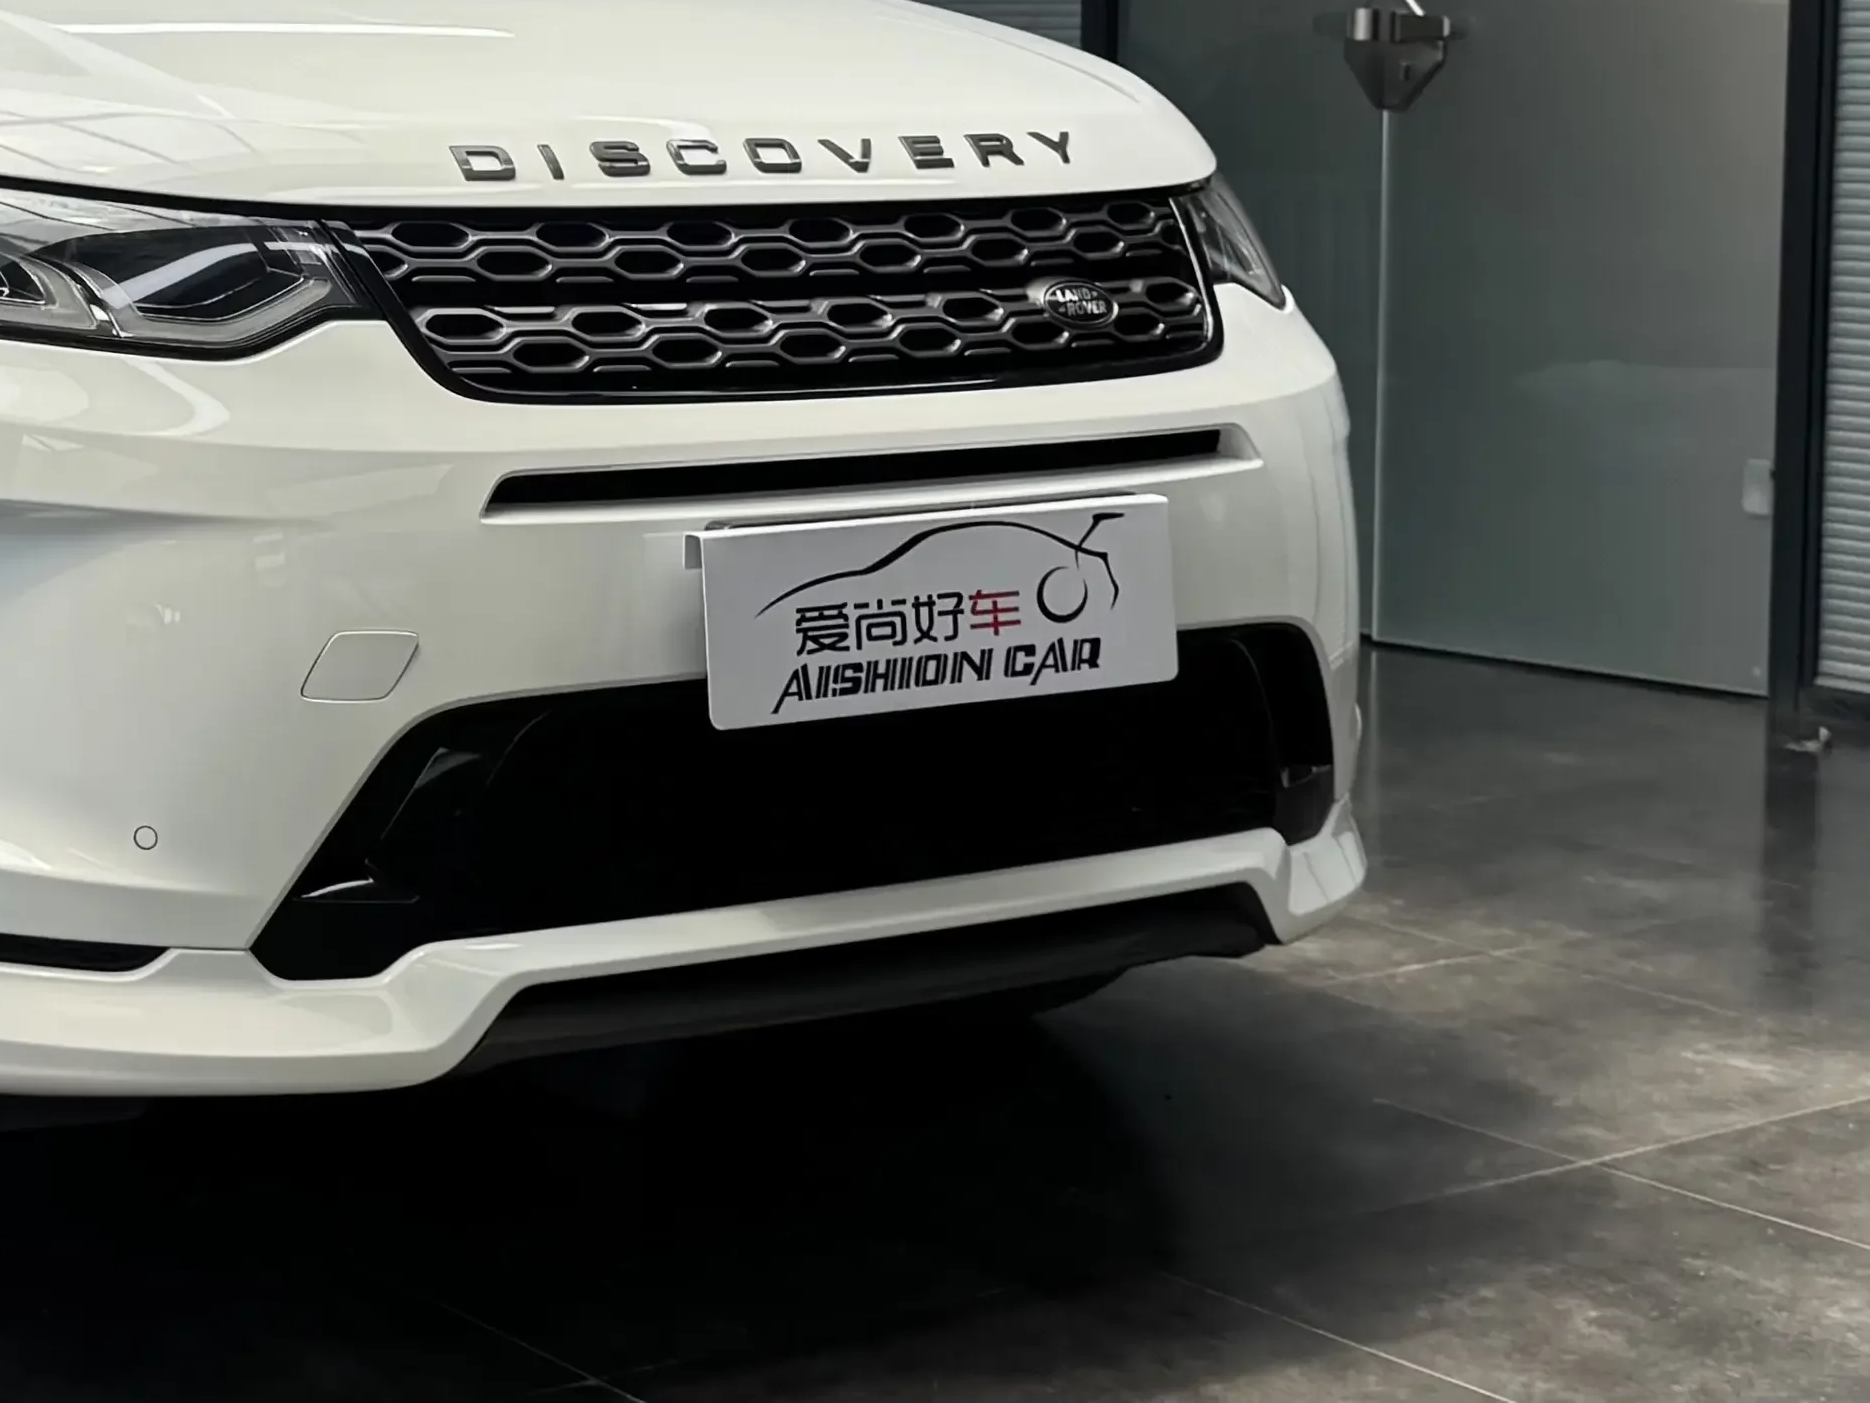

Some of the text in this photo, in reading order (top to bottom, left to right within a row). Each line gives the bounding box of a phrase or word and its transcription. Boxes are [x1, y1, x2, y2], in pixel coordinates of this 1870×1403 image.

[449, 130, 1071, 182] DISCOVERY
[1055, 286, 1091, 303] LAND
[1066, 299, 1108, 316] ROVER
[795, 589, 1022, 657] 爱尚好车
[770, 636, 1102, 715] AISHION CAR
